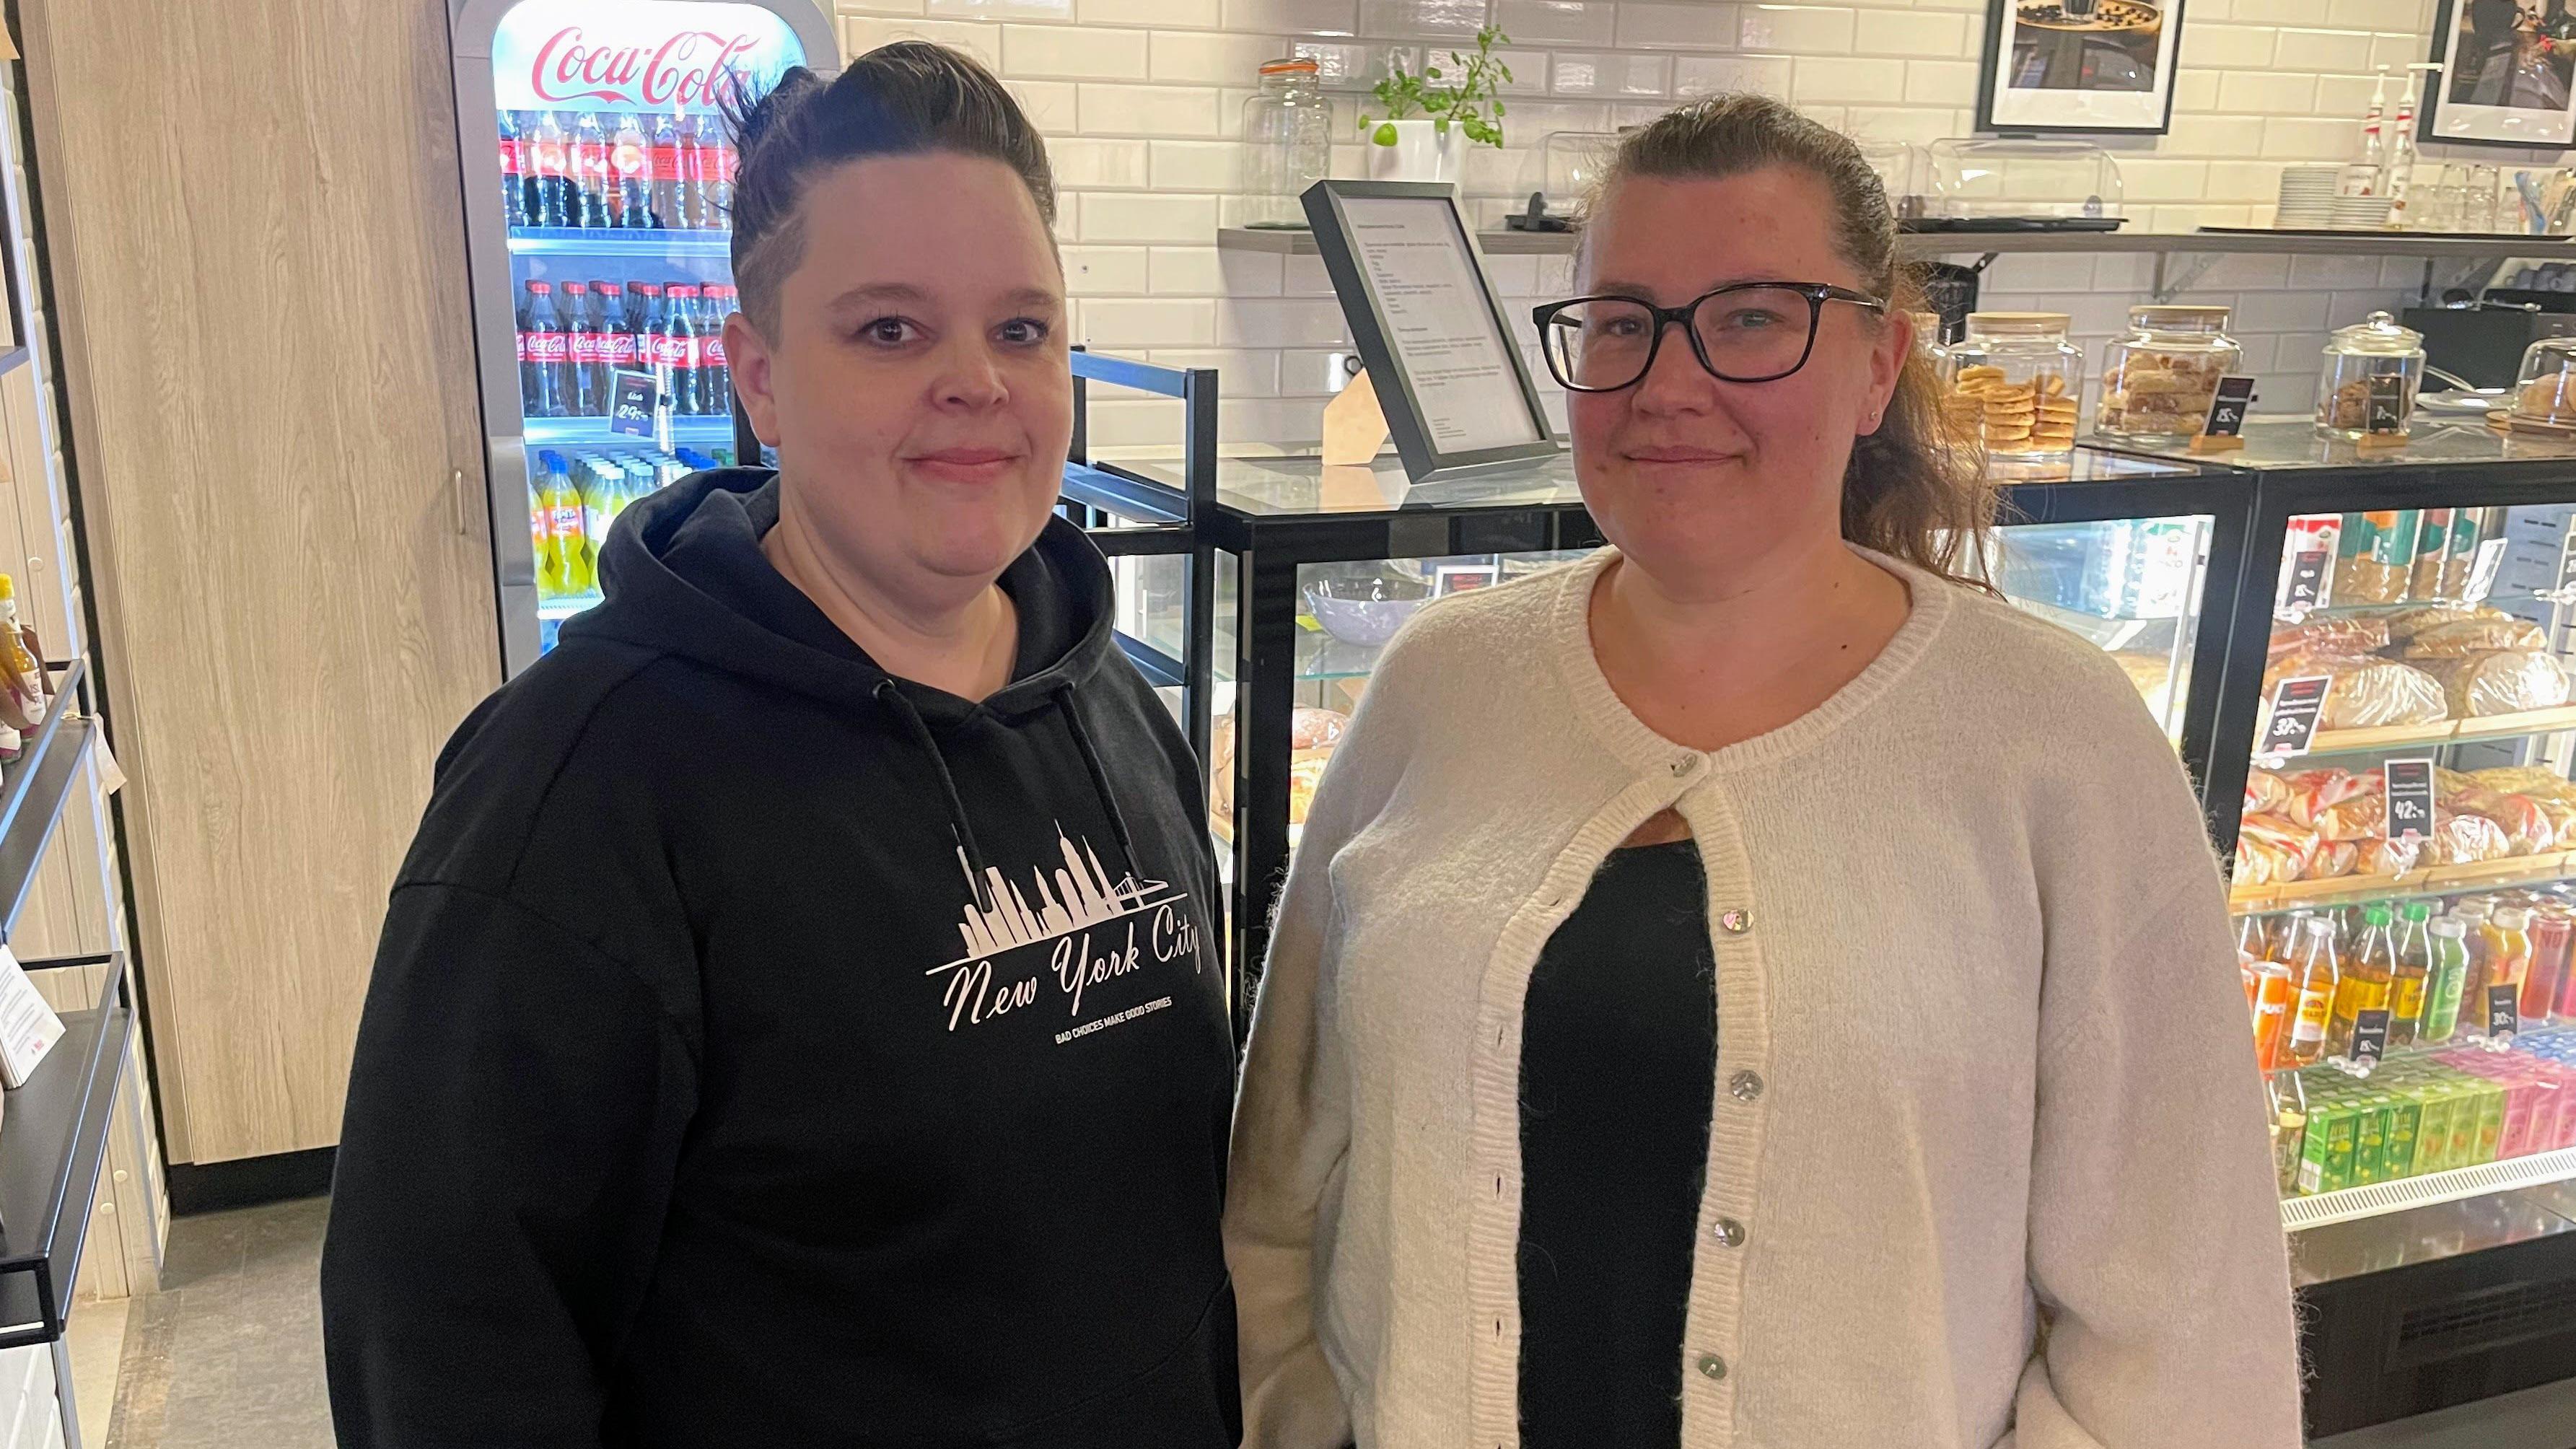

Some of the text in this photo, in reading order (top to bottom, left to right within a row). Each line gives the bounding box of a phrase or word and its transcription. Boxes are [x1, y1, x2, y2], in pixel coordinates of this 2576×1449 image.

[943, 905, 1201, 1031] New York City
[1054, 996, 1173, 1044] BAD CHOICES MAKE GOOD STORIES
